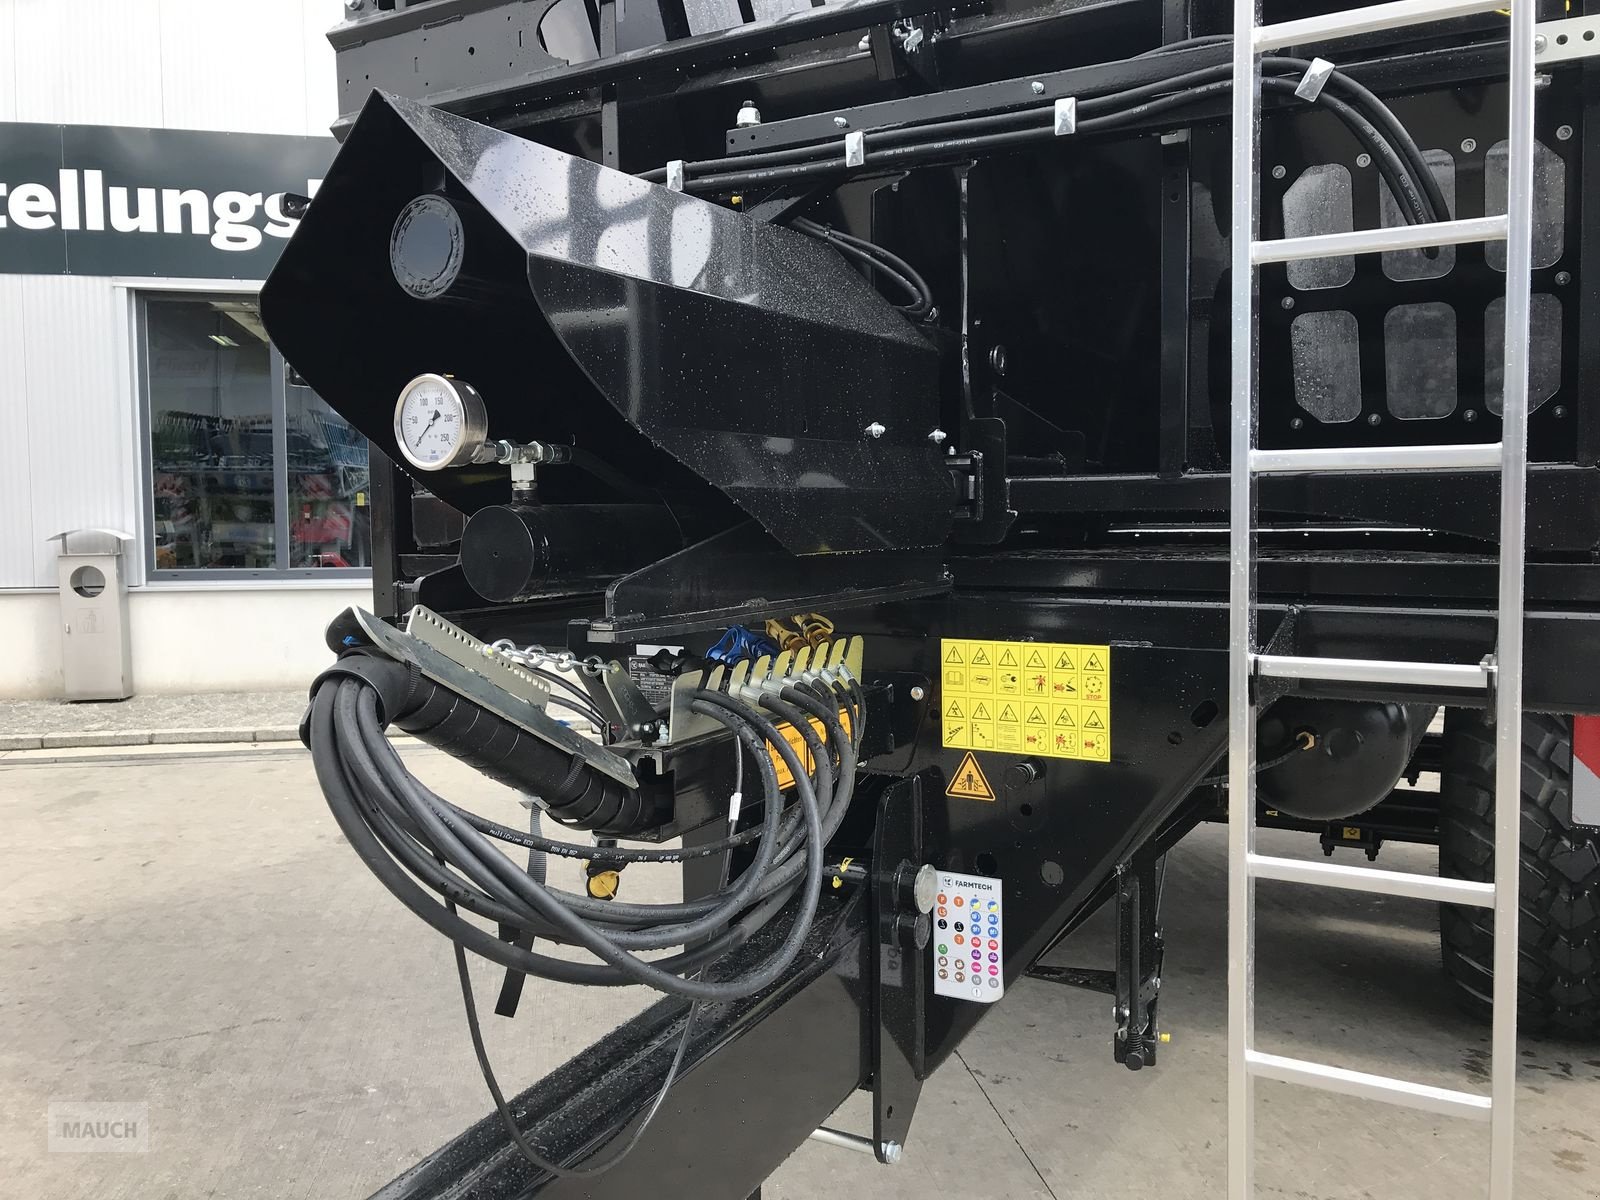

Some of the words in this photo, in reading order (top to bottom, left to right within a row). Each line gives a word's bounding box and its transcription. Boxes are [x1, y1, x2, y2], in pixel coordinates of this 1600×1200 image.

[0, 168, 323, 252] ellungs
[420, 398, 428, 406] 100
[435, 397, 443, 405] 150
[411, 416, 418, 424] 50
[444, 414, 453, 422] 200
[440, 433, 449, 442] 250
[955, 880, 992, 891] FARMTECH
